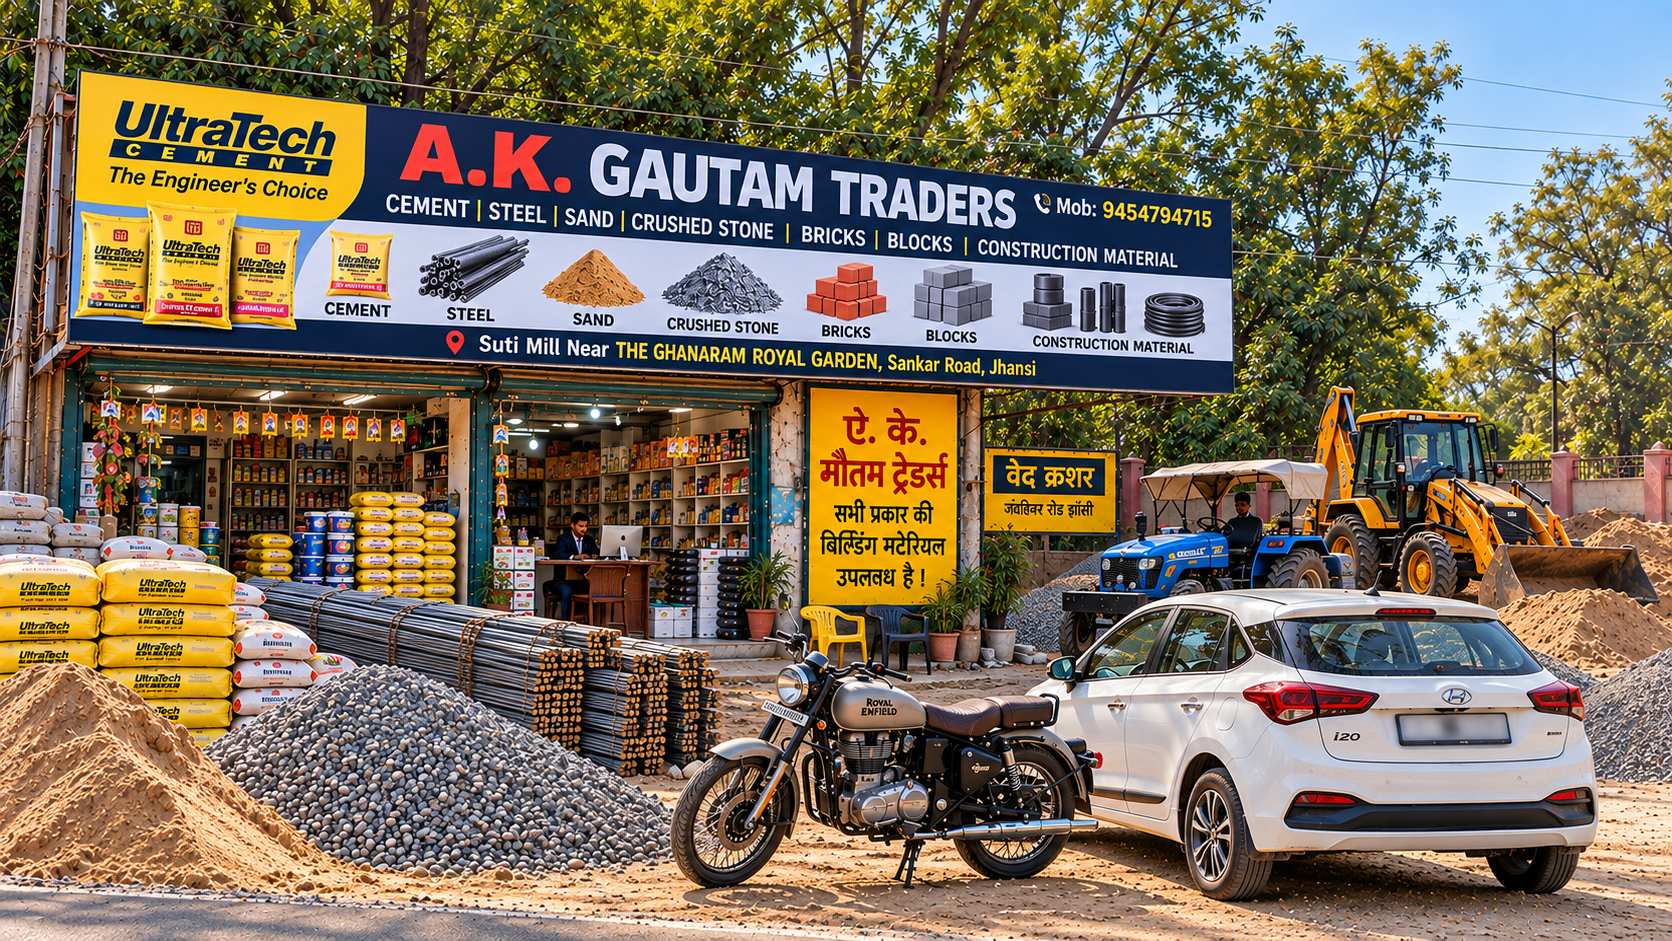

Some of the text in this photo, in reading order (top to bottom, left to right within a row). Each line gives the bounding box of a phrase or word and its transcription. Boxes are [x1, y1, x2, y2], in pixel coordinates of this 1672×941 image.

[114, 100, 336, 156] UltraTech
[125, 143, 318, 172] CEMENT
[109, 165, 329, 201] The Engineer's Choice
[399, 123, 1018, 230] A.K. GAUTAM TRADERS
[1056, 197, 1212, 228] Mob: 9454794715
[386, 193, 1179, 268] CEMENT STEEL SAND CRUSHED STONE BRICKS BLOCKS CONSTRUCTION MATERIAL
[163, 239, 221, 254] UltraTech
[324, 301, 392, 318] CEMENT
[446, 306, 495, 322] STEEL
[572, 312, 615, 327] SAND
[667, 317, 779, 335] CRUSHED STONE
[821, 324, 871, 339] BRICKS
[926, 329, 977, 344] BLOCKS
[479, 334, 1036, 377] Suti Mill Near THE GHANARAM ROYAL GARDEN, Sankar Road, Jhansi
[1032, 334, 1195, 355] CONSTRUCTION MATERIAL
[842, 406, 927, 446] ऐ. के.
[891, 451, 949, 495] ट्रेडर्स
[1005, 457, 1096, 489] वेद क्रशर
[833, 498, 935, 525] सभी प्रकार की
[1045, 499, 1065, 516] रोड
[882, 530, 947, 556] मटेरियल
[901, 561, 915, 590] है
[861, 707, 898, 716] ENFIELD
[866, 697, 893, 707] ROYAL
[1333, 730, 1361, 742] i20
